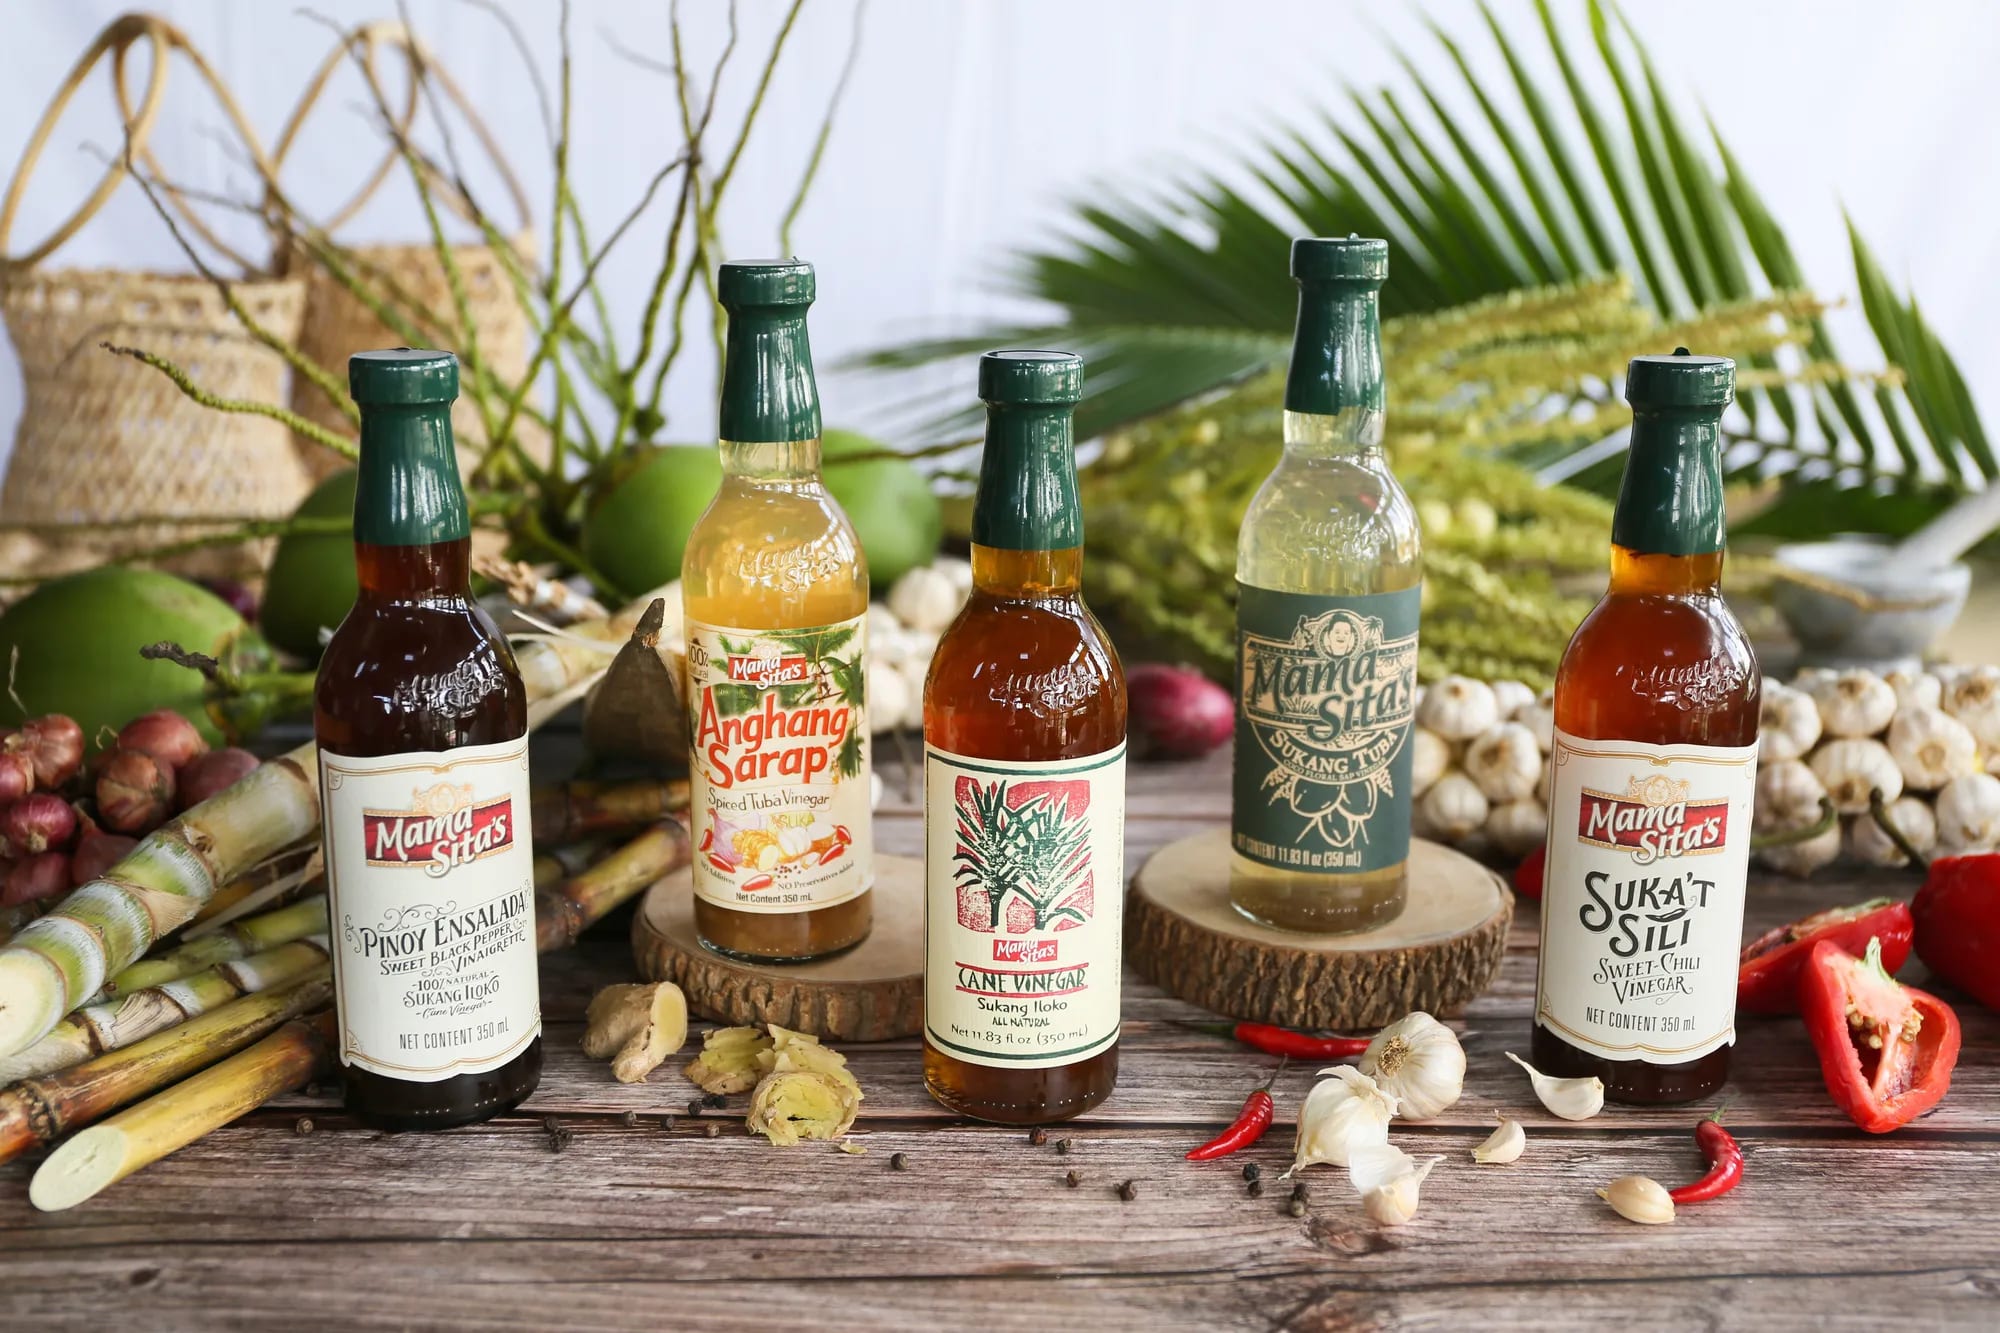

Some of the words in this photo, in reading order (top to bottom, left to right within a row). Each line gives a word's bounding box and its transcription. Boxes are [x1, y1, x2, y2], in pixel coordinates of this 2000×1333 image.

[688, 644, 709, 667] 100%
[732, 656, 781, 680] Mama
[756, 663, 802, 690] Sita's
[1252, 651, 1378, 714] Mama
[697, 686, 849, 754] Anghang
[708, 742, 828, 789] Sarap
[1269, 730, 1348, 773] SUKANG
[1283, 759, 1304, 776] COCO
[1305, 768, 1337, 781] FLORAL
[1339, 771, 1355, 781] SAP
[708, 787, 746, 810] Spiced
[782, 788, 830, 808] Vinegar
[376, 805, 473, 861] Mama
[1587, 801, 1688, 844] Mama
[424, 814, 507, 878] Sita's
[1631, 816, 1721, 864] Sita's
[1311, 853, 1321, 866] oz
[794, 872, 839, 889] Preservatives
[736, 892, 749, 902] Net
[750, 892, 781, 903] Content
[783, 893, 798, 903] 350
[800, 893, 812, 902] mL
[1579, 871, 1716, 933] SUKA'T
[360, 927, 427, 958] PINOY
[434, 890, 525, 947] ENSALADA
[1609, 913, 1691, 957] SILI
[380, 958, 426, 975] SWEET
[431, 940, 470, 967] BLACK
[474, 923, 513, 950] PEPPER
[451, 931, 526, 973] VINAIGRETTE
[997, 940, 1039, 958] Mama
[1017, 944, 1056, 964] Sita's
[959, 968, 1006, 993] CANE
[1593, 953, 1701, 984] SWEET-CHILI
[403, 989, 461, 1008] SUKANG
[465, 975, 500, 1000] ILOKO
[1612, 976, 1694, 1005] VINEGAR
[422, 1007, 448, 1019] Cane
[450, 1000, 487, 1017] Vinegar
[977, 997, 1028, 1017] Sukang
[1034, 999, 1068, 1013] Iloko
[1586, 1007, 1604, 1025] NET
[1609, 1012, 1657, 1032] CONTENT
[1661, 1016, 1680, 1032] 350
[1683, 1016, 1696, 1031] mL
[400, 1033, 419, 1049] NET
[424, 1027, 472, 1049] CONTENT
[477, 1021, 494, 1041] 350
[497, 1017, 509, 1034] mL
[951, 1024, 968, 1038] Net
[972, 1030, 1002, 1045] 11.83
[1006, 1033, 1014, 1043] fl
[1037, 1031, 1065, 1045] (350
[1069, 1024, 1088, 1039] mL)
[992, 1017, 1008, 1026] ALL
[1010, 1017, 1051, 1027] NATURAL
